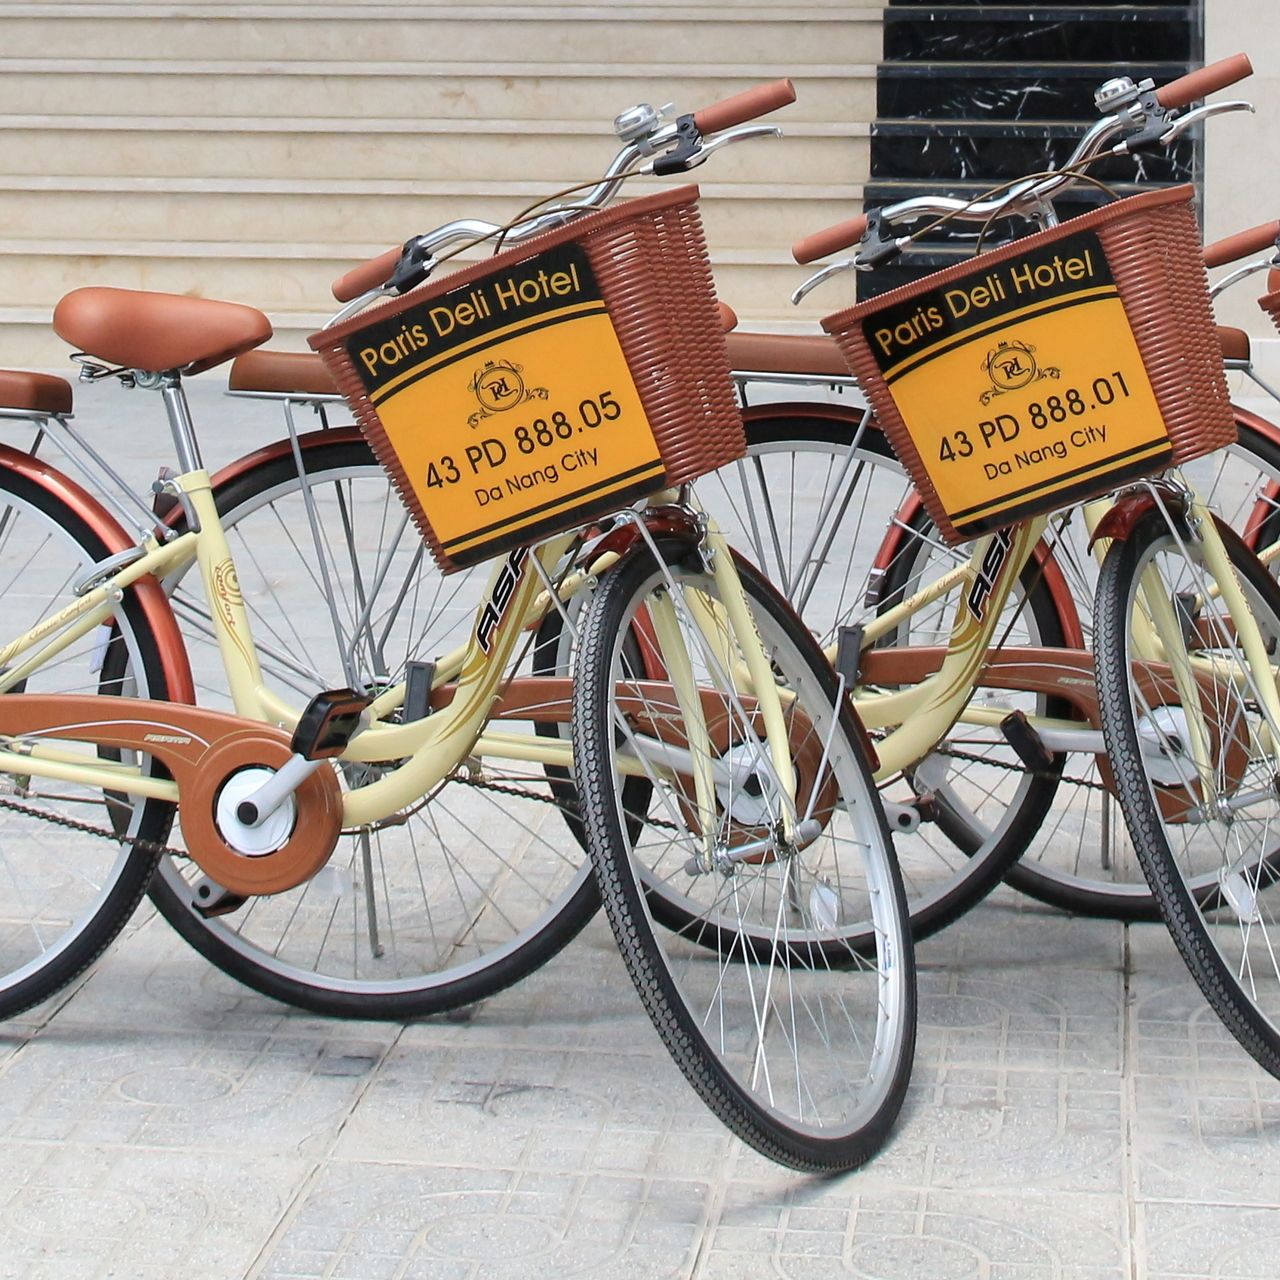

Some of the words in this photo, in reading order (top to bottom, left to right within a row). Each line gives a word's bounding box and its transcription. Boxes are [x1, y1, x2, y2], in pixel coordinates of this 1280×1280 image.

[360, 325, 428, 376] Paris
[429, 287, 490, 336] Deli
[495, 264, 579, 310] Hotel
[874, 308, 942, 355] Paris
[945, 274, 1005, 318] Deli
[1011, 250, 1093, 293] Hotel
[427, 456, 460, 488] 43
[465, 439, 506, 474] PD
[515, 390, 621, 454] 888.05
[940, 431, 973, 461] 43
[979, 415, 1019, 448] PD
[1029, 370, 1130, 430] 888.01
[984, 461, 1012, 480] Da
[1015, 441, 1067, 469] Nang
[1071, 425, 1105, 447] City
[475, 486, 503, 506] Da
[506, 465, 558, 494] Nang
[561, 448, 597, 471] City
